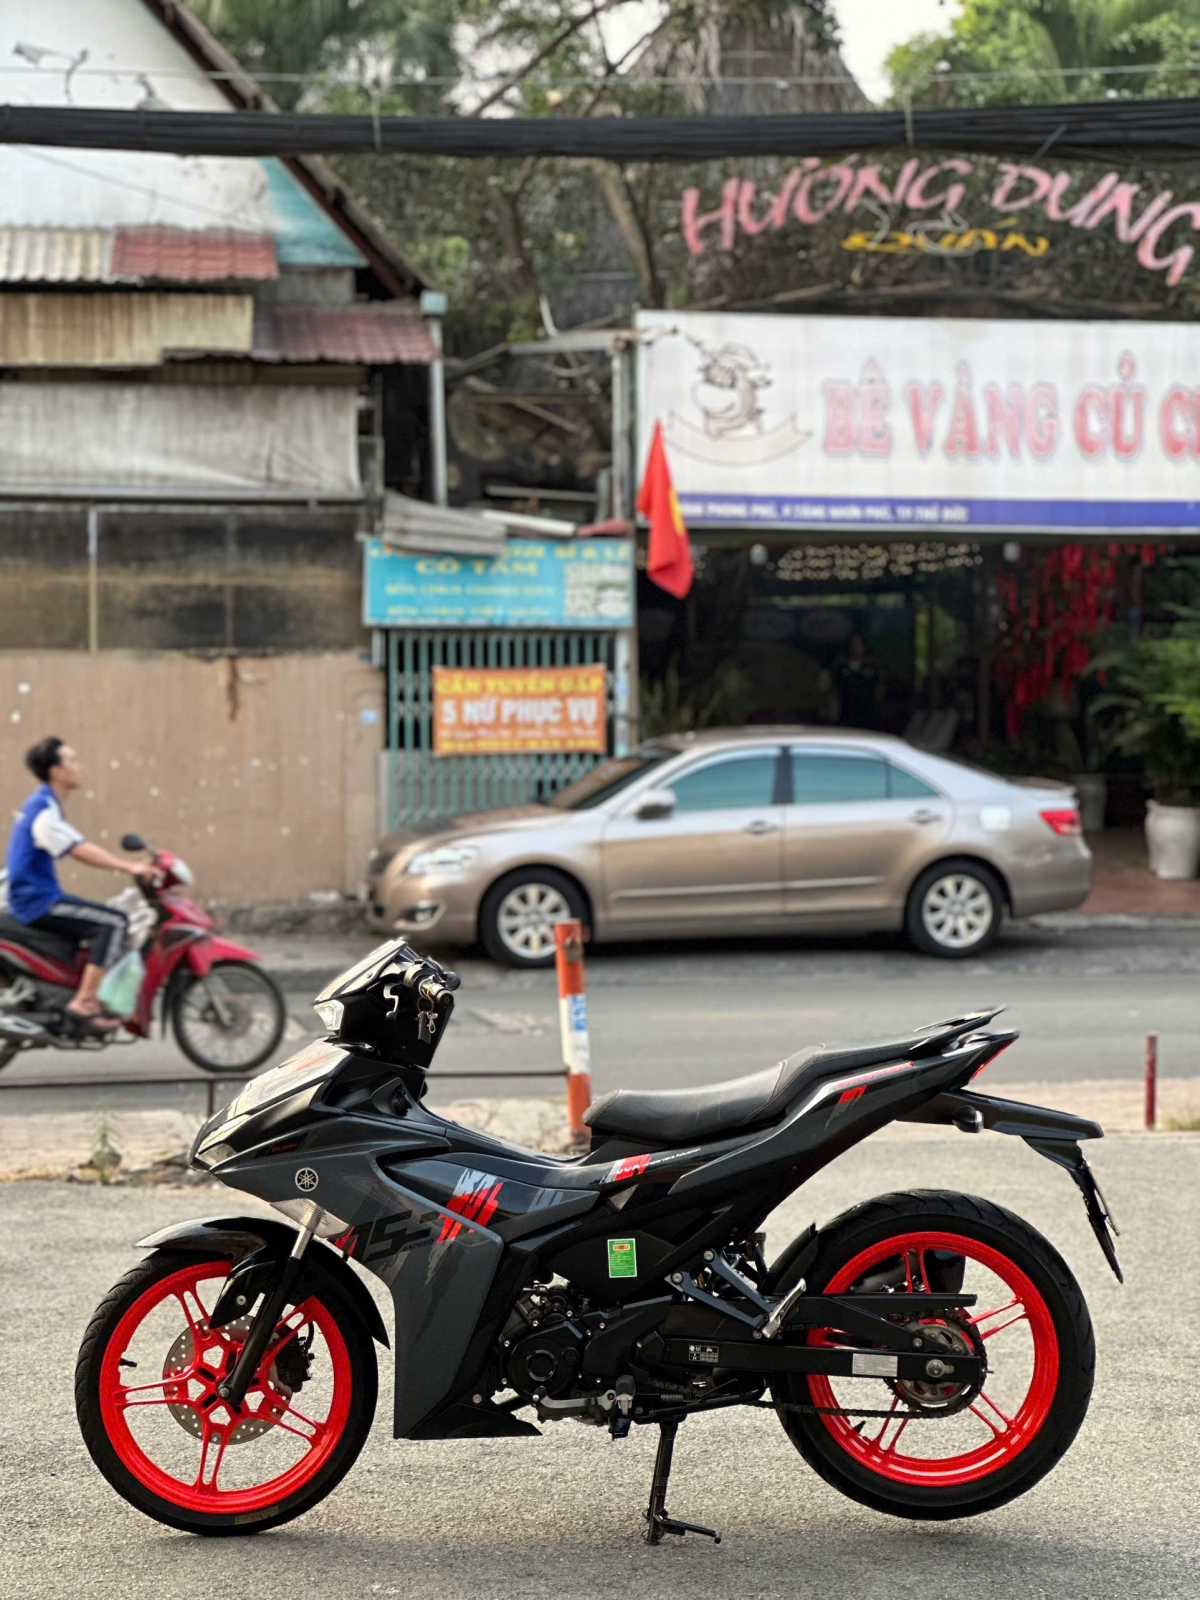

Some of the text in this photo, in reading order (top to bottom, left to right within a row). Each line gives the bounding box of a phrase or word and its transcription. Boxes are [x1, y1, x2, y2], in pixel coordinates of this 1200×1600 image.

[821, 354, 894, 460] BÊ
[1073, 348, 1148, 460] CỦ
[461, 693, 498, 726] NỮ
[501, 697, 563, 728] PHỤC
[566, 697, 598, 728] VỤ
